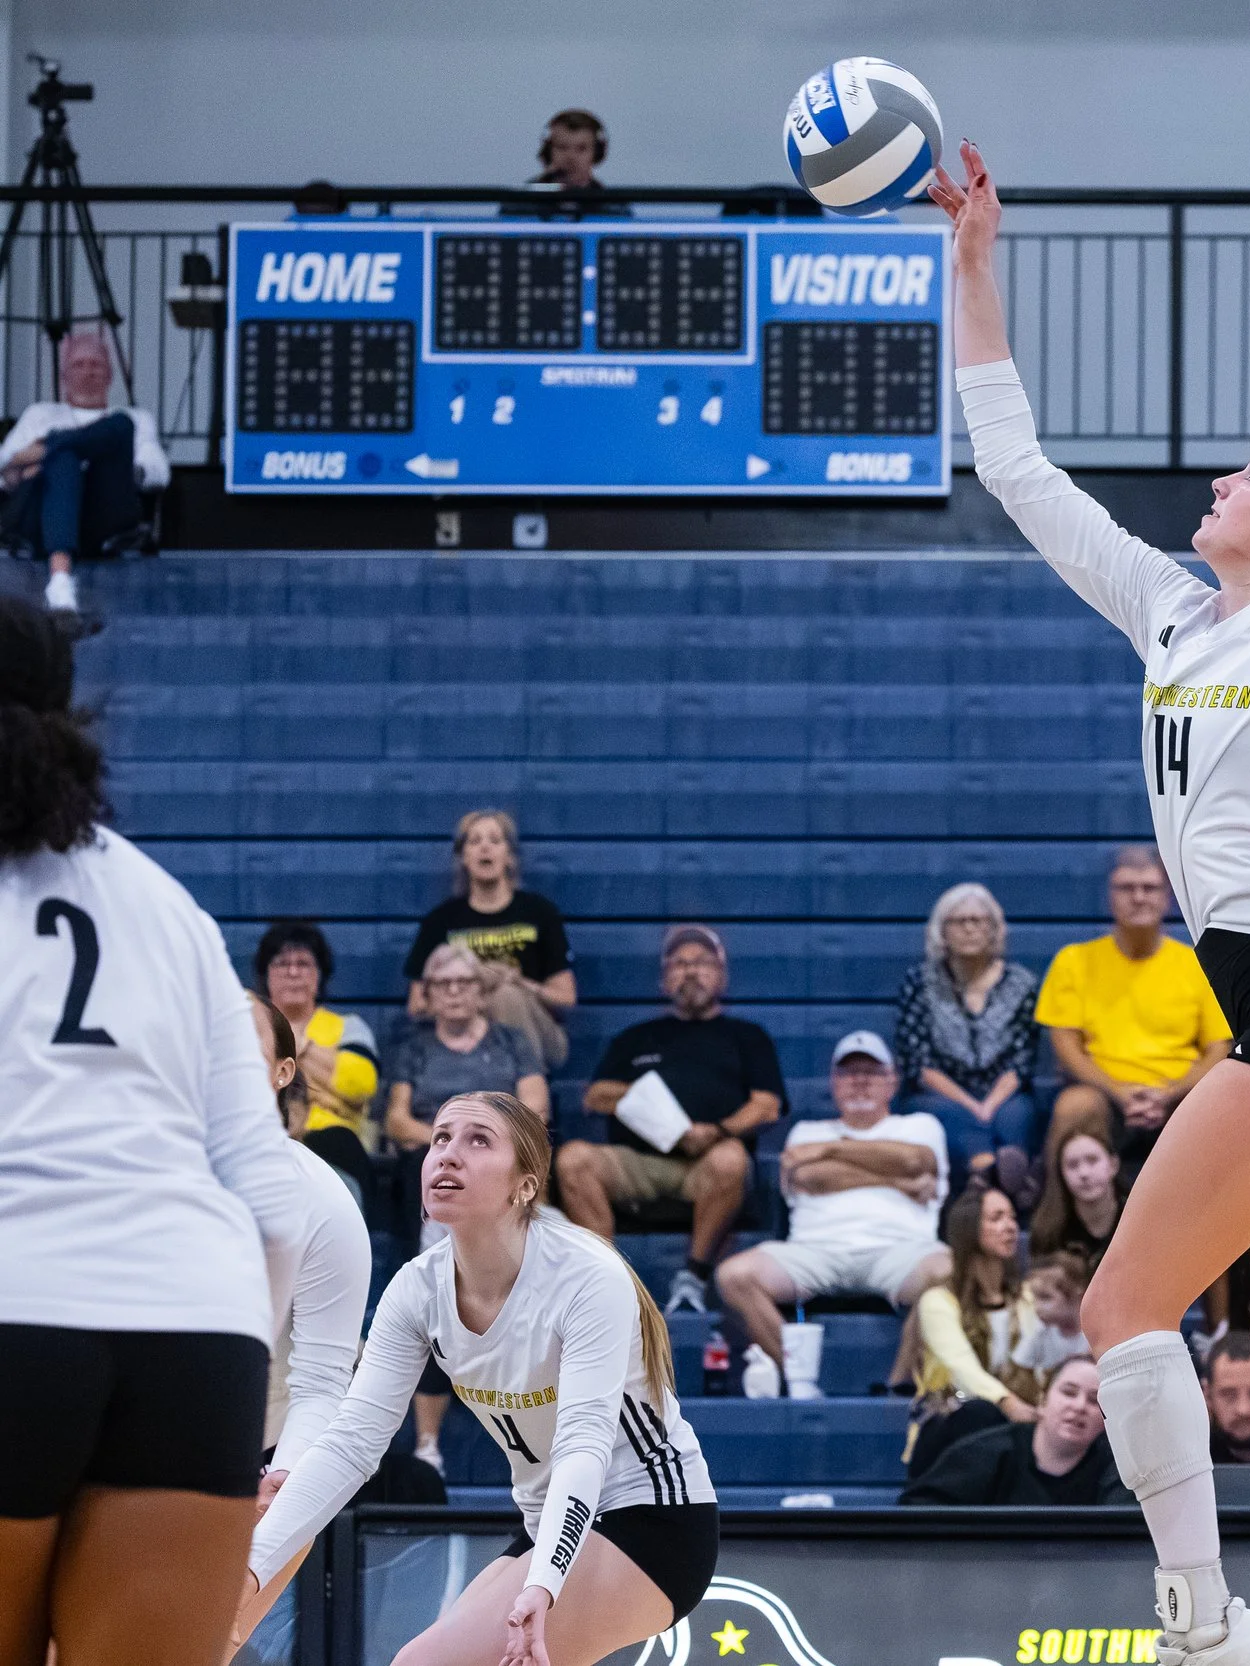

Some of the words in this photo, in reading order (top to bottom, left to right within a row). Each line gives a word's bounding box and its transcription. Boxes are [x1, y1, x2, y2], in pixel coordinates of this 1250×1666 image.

[256, 252, 400, 303] HOME
[770, 254, 933, 306] VISITOR
[450, 396, 464, 424] 1
[493, 396, 516, 424] 2
[658, 396, 680, 425] 3
[701, 396, 724, 425] 4
[262, 451, 347, 481] BONUS
[827, 453, 914, 482] BONUS
[1154, 714, 1192, 796] 14
[35, 896, 119, 1047] 2
[489, 1413, 541, 1464] 4
[550, 1495, 592, 1577] PIRATES
